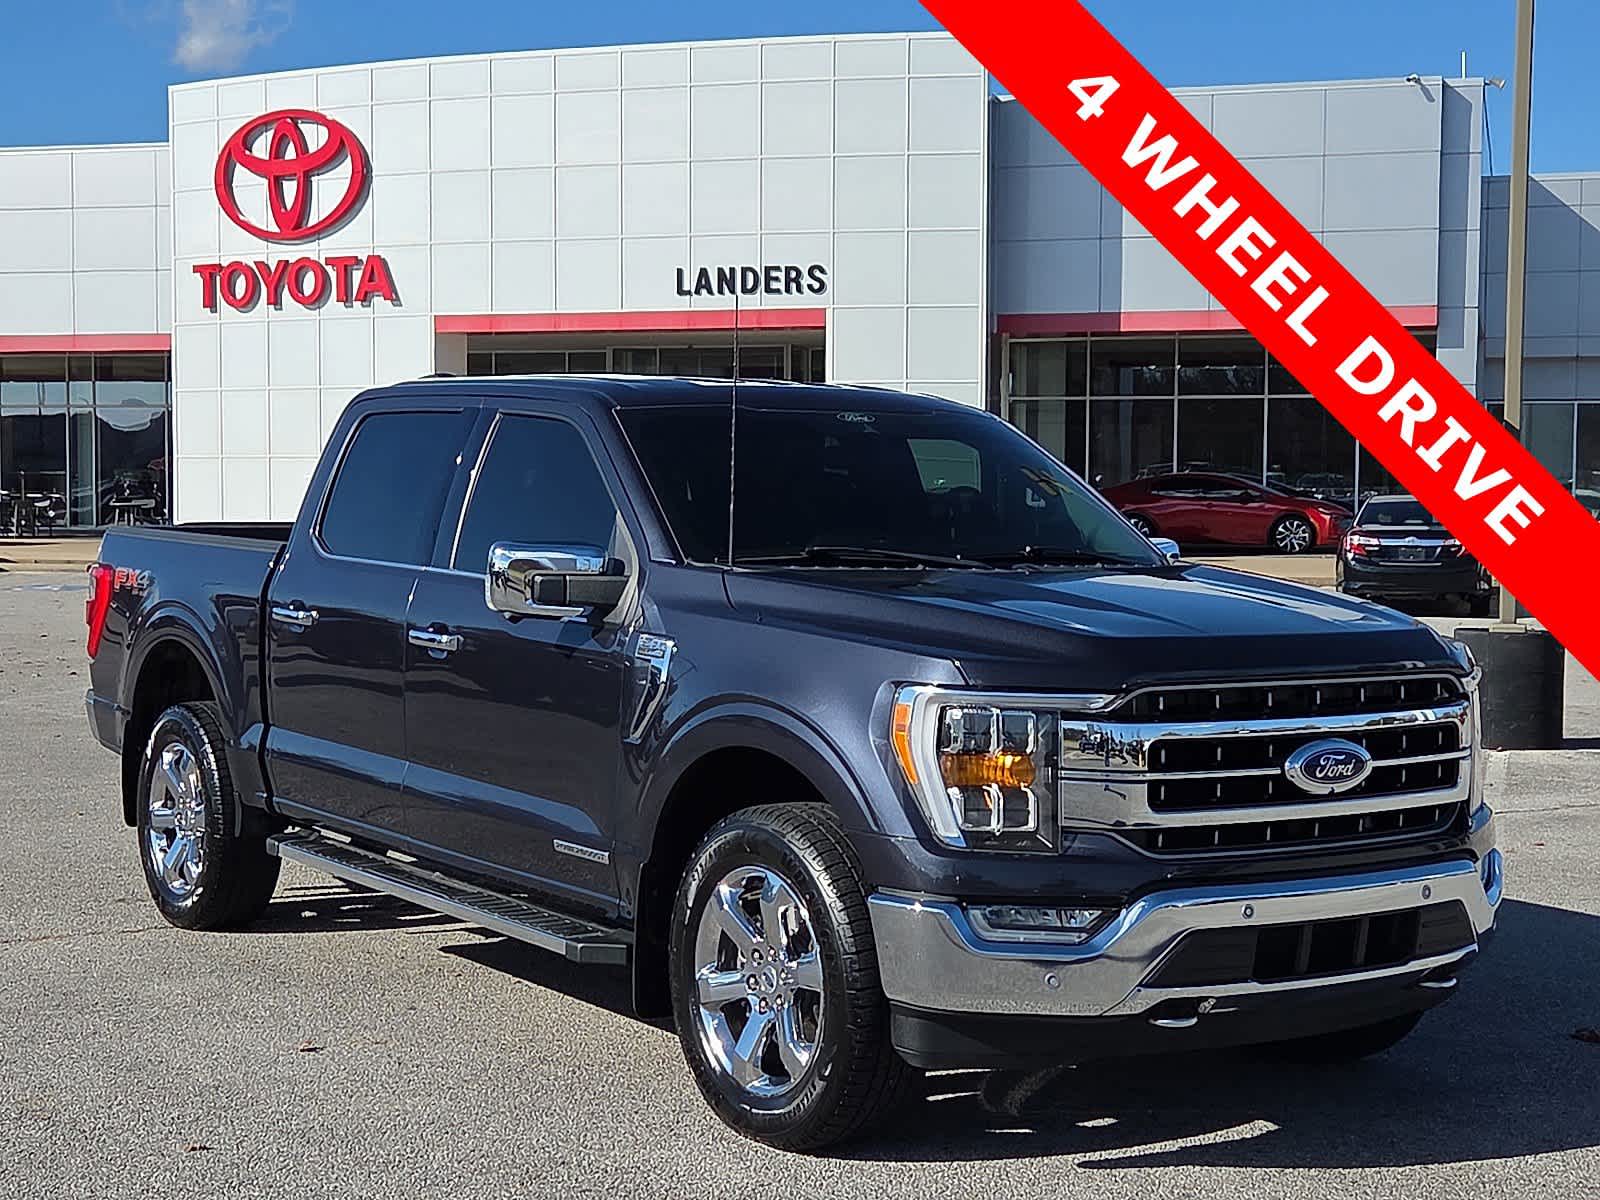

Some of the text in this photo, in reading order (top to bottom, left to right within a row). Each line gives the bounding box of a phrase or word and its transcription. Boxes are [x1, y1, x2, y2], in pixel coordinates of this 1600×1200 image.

[193, 255, 402, 313] TOYOTA
[676, 264, 828, 296] LANDERS
[113, 566, 152, 590] FX4
[1315, 754, 1356, 778] Ford
